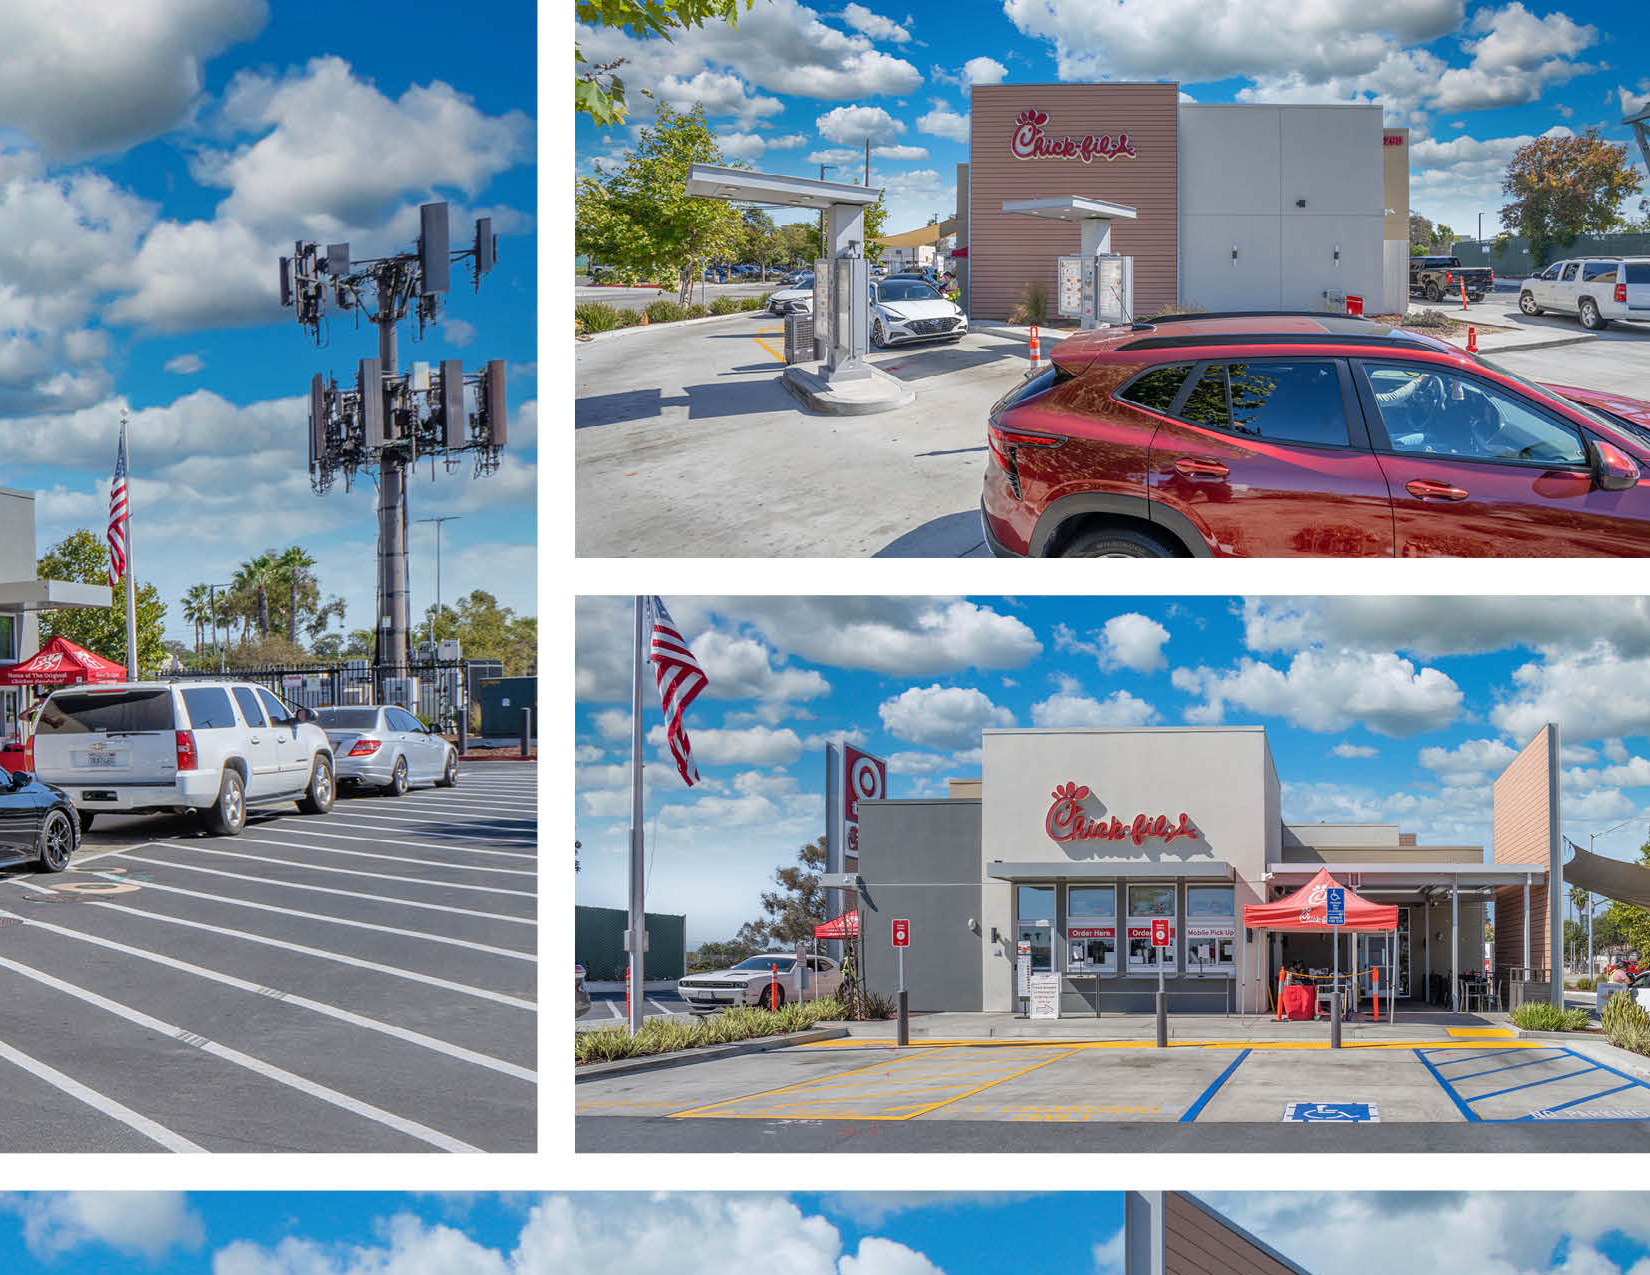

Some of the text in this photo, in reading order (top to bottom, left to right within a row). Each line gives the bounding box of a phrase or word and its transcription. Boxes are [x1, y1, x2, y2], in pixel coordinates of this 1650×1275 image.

[1012, 109, 1135, 162] Chick-fil-A
[1046, 781, 1198, 846] Chick-fil-A
[1225, 929, 1235, 937] Up
